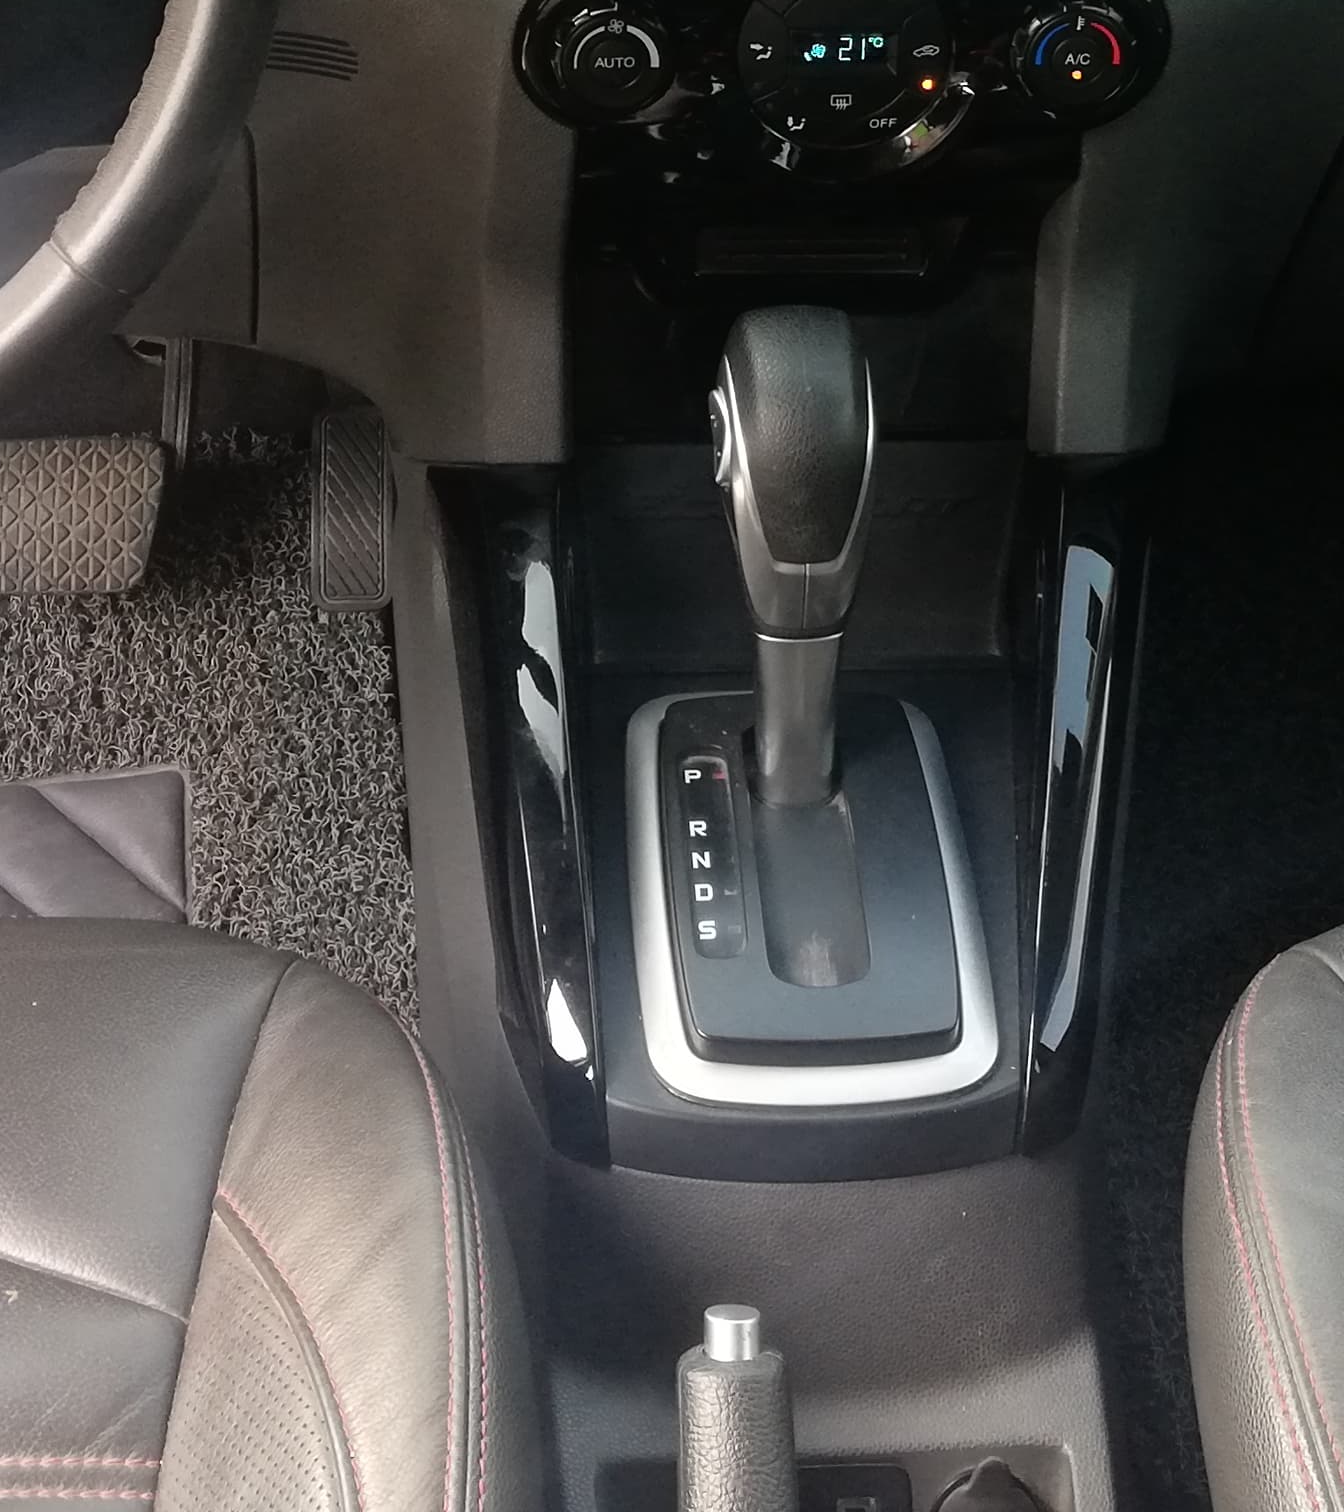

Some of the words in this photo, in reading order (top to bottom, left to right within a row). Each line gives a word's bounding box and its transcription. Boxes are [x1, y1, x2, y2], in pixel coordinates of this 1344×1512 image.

[594, 56, 636, 68] AUTO
[1064, 53, 1091, 65] A/C
[869, 118, 898, 129] OFF
[683, 769, 702, 784] P
[689, 820, 707, 837] R
[691, 851, 711, 869] N
[694, 883, 714, 902] D
[698, 920, 717, 940] S
